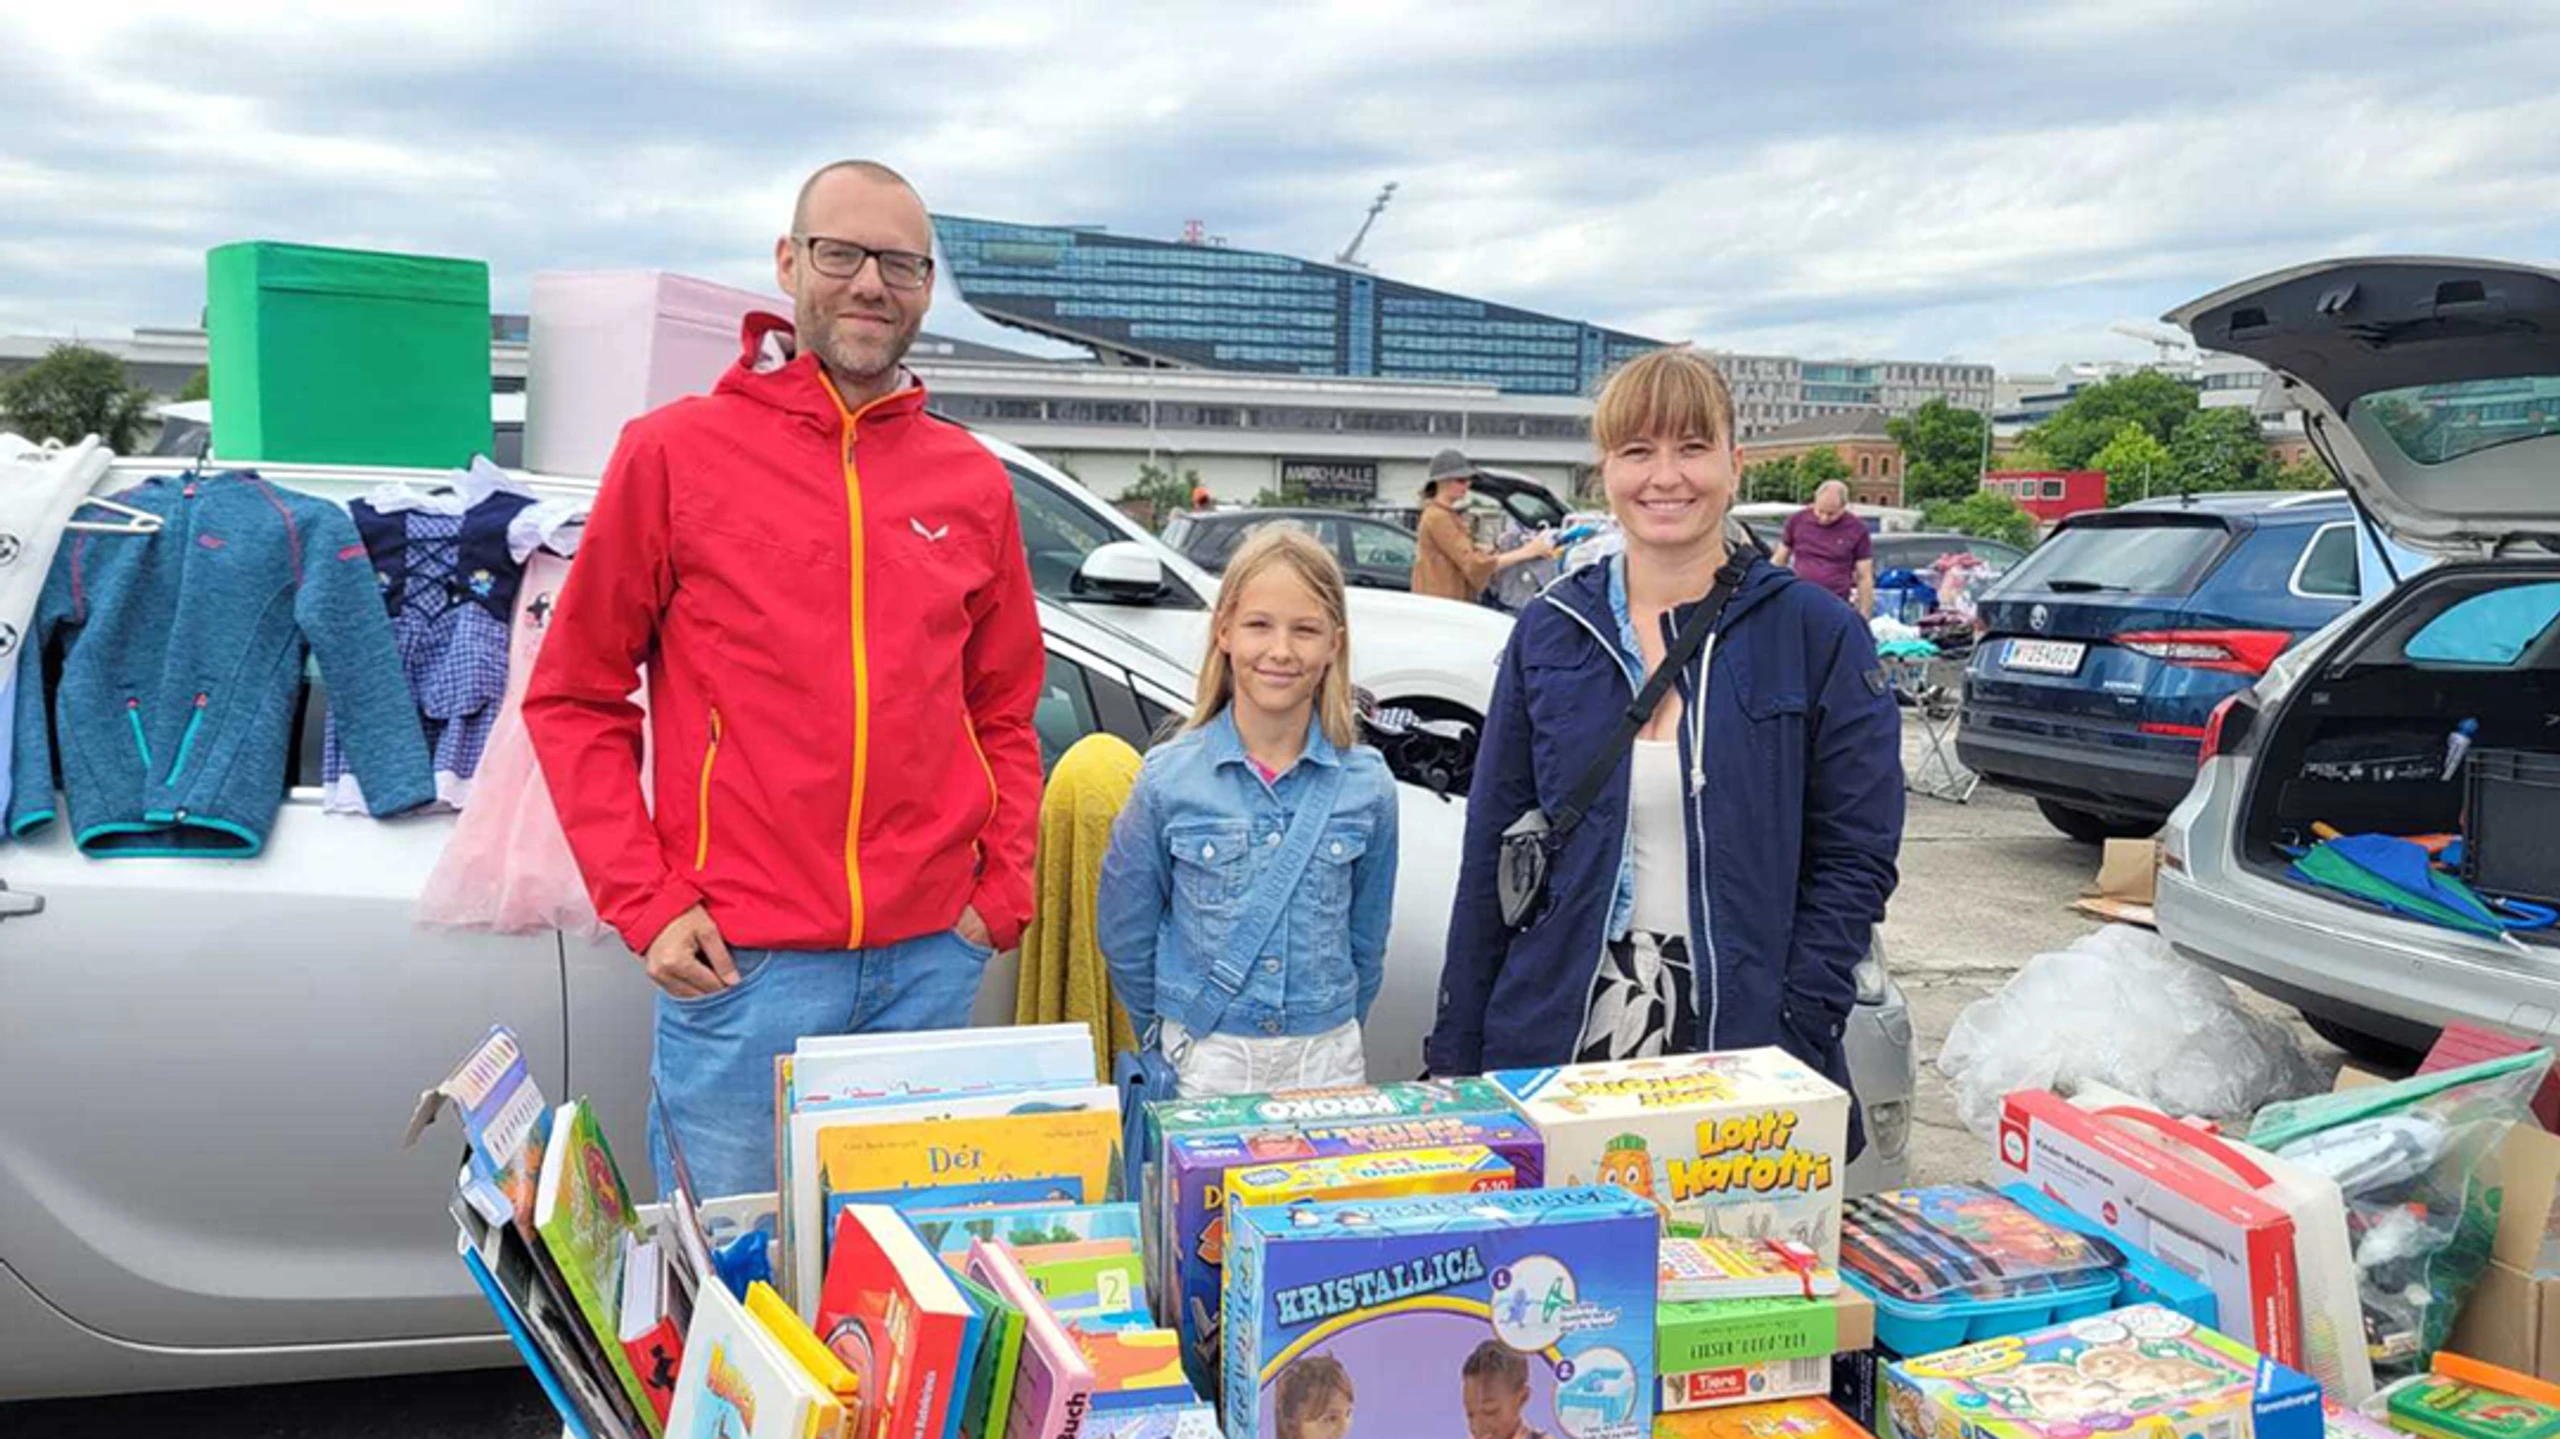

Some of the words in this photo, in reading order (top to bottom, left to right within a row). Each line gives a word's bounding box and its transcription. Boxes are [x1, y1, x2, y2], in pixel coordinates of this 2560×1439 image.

[1695, 1110, 1798, 1156] Lotti
[1667, 1147, 1832, 1203] Karotti
[1275, 1246, 1485, 1326] KRISTALLICA
